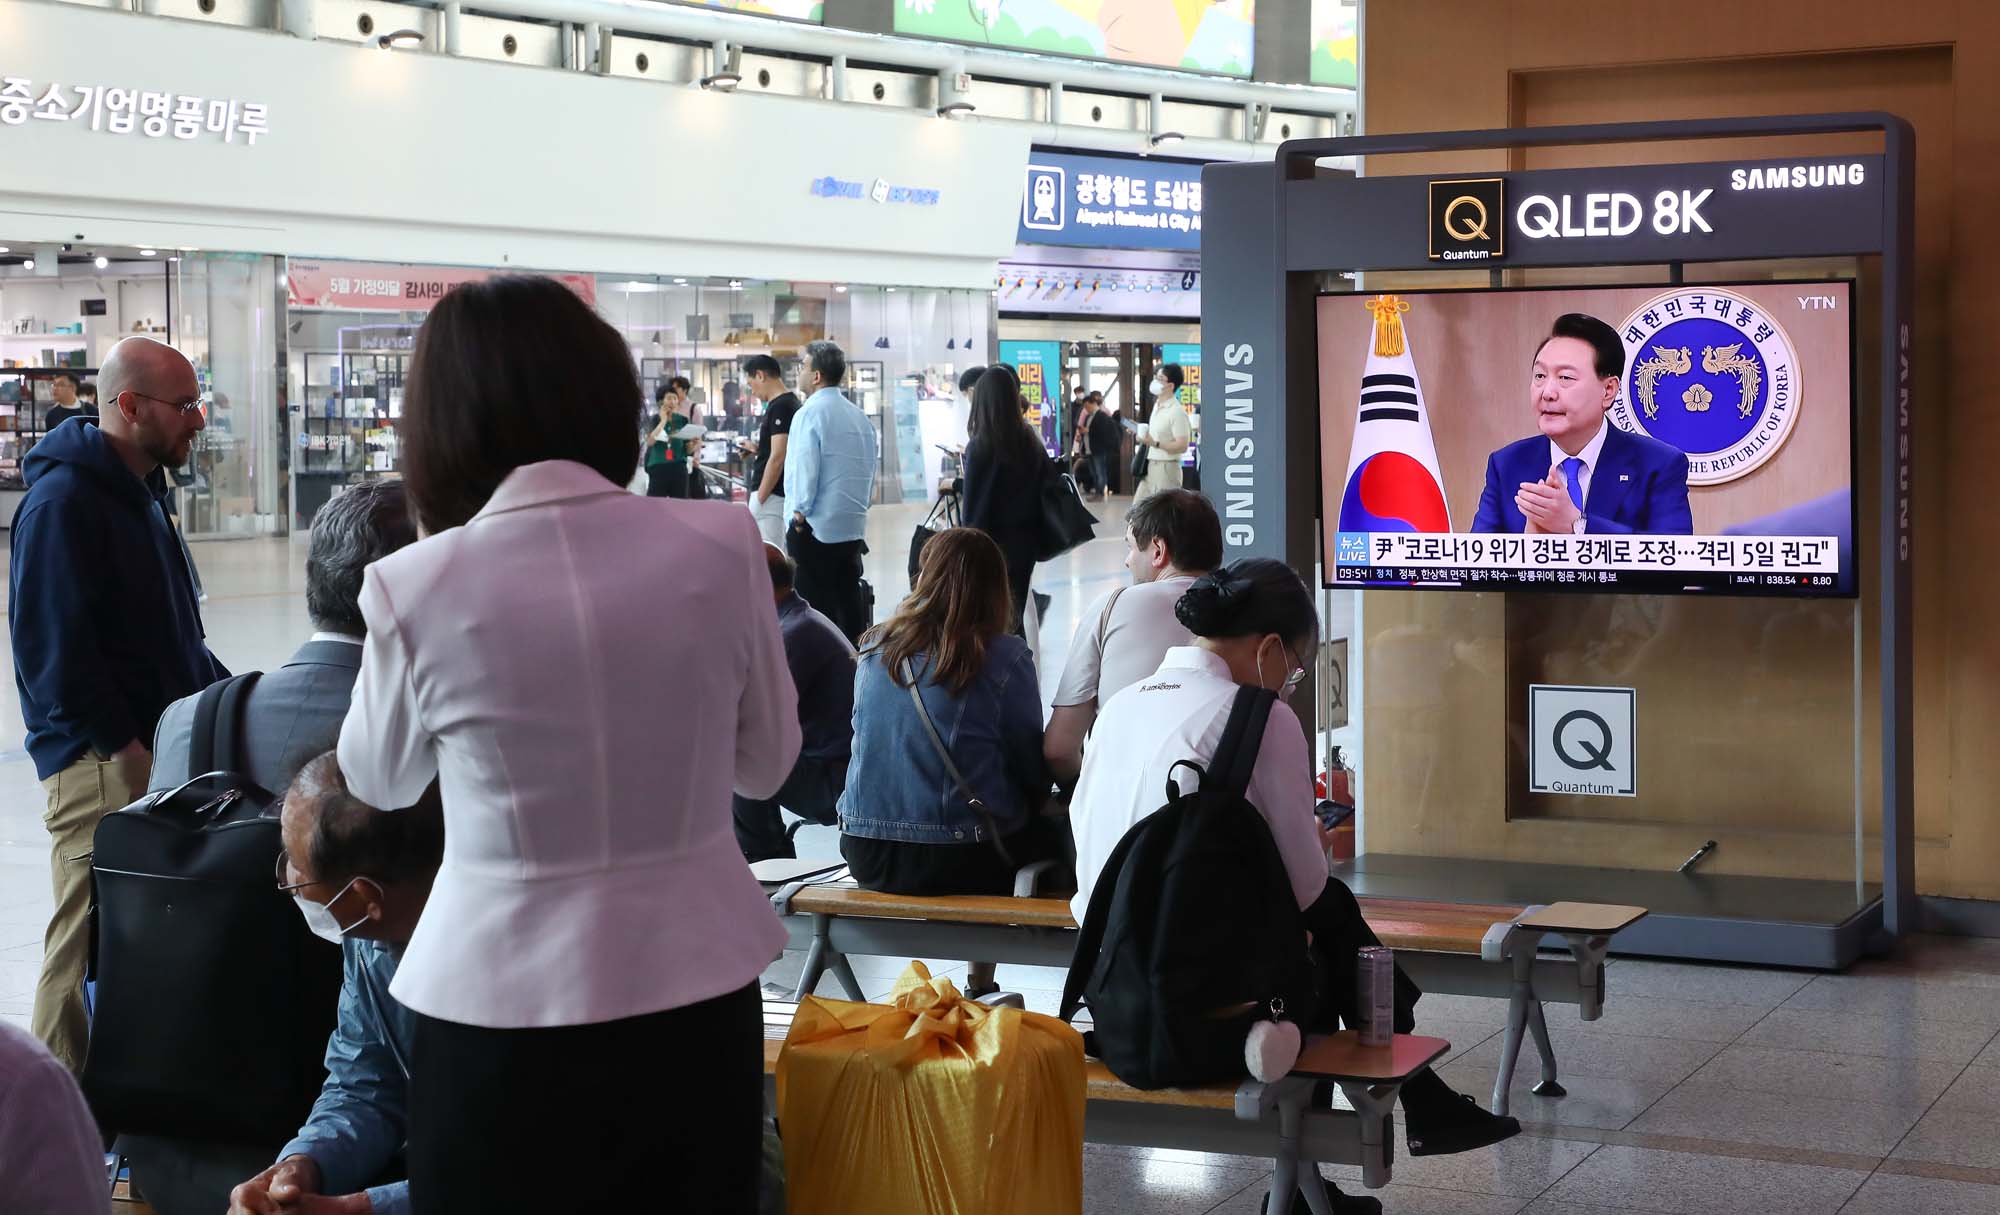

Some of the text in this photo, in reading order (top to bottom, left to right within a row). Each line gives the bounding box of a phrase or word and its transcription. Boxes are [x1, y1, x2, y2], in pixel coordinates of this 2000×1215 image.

[0, 77, 269, 145] 중소기업명품마루
[1076, 174, 1148, 207] 공항철도
[1731, 163, 1865, 191] SAMSUNG
[1076, 207, 1114, 227] Airport
[1115, 210, 1158, 228] Railroad
[1169, 213, 1191, 232] City
[1444, 195, 1491, 241] Q
[1516, 188, 1714, 239] QLED 8K
[1443, 249, 1489, 260] Quantum
[330, 278, 350, 293] 5월
[405, 282, 444, 299] 감사의
[1797, 296, 1837, 310] YTN
[1625, 296, 1775, 345] 대한민국대통령
[1689, 461, 1708, 473] HE
[1711, 430, 1771, 472] REPUBLIC
[1766, 411, 1781, 431] OF
[1775, 363, 1789, 416] KOREA
[1223, 343, 1255, 546] SAMSUNG
[1899, 323, 1909, 561] SAMSUNG
[1339, 551, 1366, 561] LIVE
[1340, 536, 1364, 549] 뉴스
[1376, 538, 1393, 561] 尹
[1398, 536, 1483, 563] "코로나19
[1489, 538, 1526, 564] 위기
[1532, 538, 1570, 564] 경보
[1575, 539, 1633, 565] 경계로
[1743, 541, 1774, 567] 5일
[1781, 540, 1829, 567] 권고"
[1339, 568, 1368, 579] 09:54
[1376, 568, 1393, 579] 정치
[1399, 568, 1419, 580] 정부,
[1422, 569, 1448, 580] 한상혁
[1450, 569, 1468, 581] 면직
[1471, 570, 1488, 581] 절차
[1557, 571, 1576, 583] 청문
[1578, 571, 1596, 583] 개시
[1598, 571, 1617, 583] 통보
[1737, 575, 1832, 585] 코스닥 838.54 8.80
[1552, 709, 1616, 771] Q
[1552, 781, 1614, 795] Quantum
